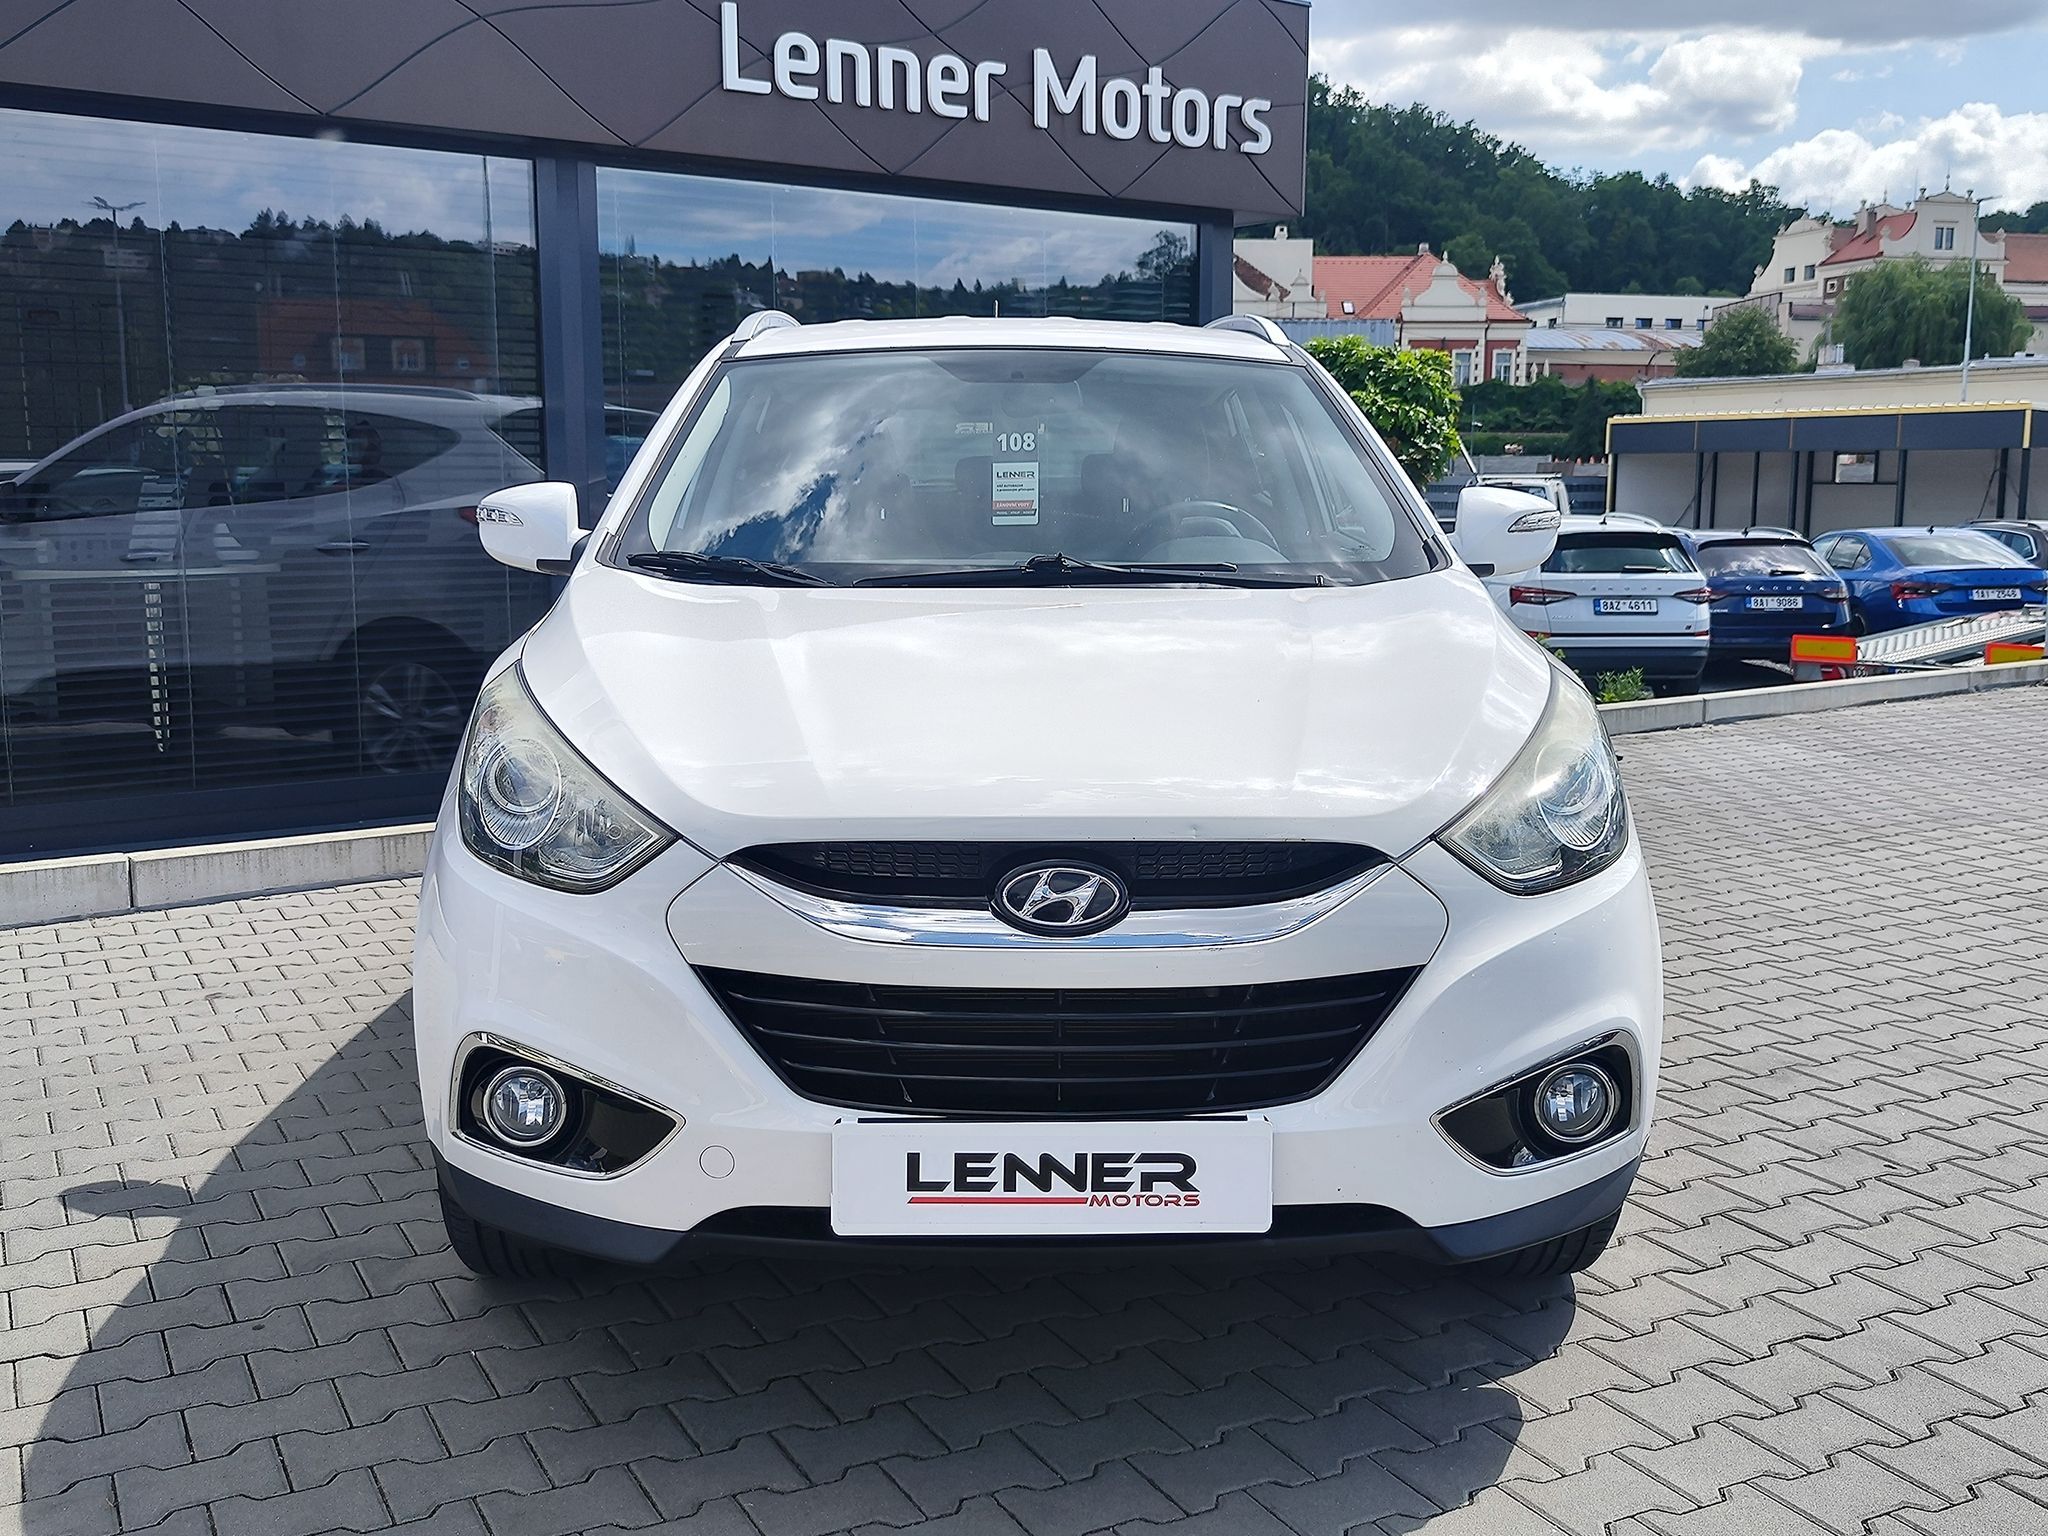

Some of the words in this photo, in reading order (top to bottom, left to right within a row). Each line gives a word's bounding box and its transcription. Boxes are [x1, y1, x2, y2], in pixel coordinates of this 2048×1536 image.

[720, 1, 1007, 122] Lenner
[1032, 47, 1272, 155] Motors
[996, 432, 1036, 452] 108
[996, 471, 1035, 479] LENNER
[1628, 600, 1652, 611] 4611
[906, 1152, 1200, 1193] LENNER
[1089, 1194, 1200, 1207] MOTORS
